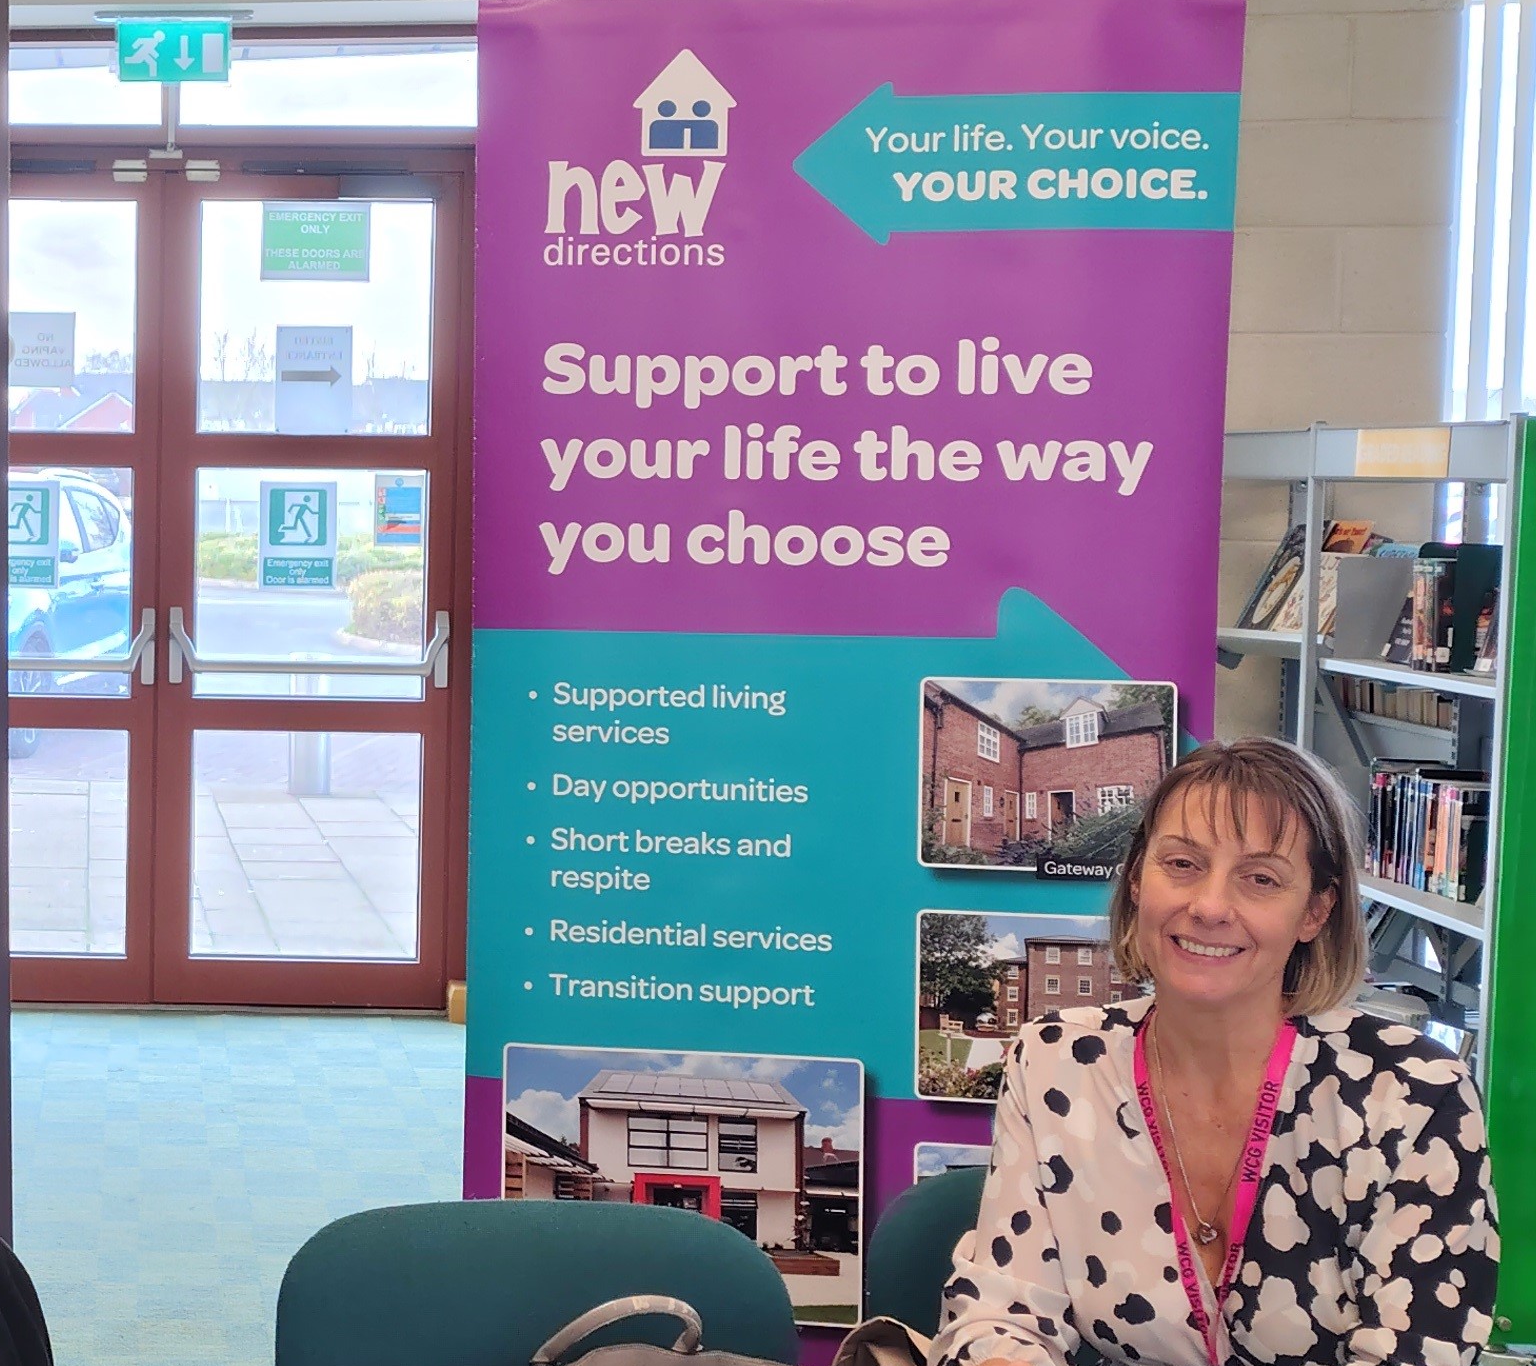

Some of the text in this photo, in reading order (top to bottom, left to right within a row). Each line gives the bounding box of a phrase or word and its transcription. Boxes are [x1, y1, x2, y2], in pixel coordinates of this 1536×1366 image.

[866, 122, 1209, 152] Your life. Your voice.
[544, 160, 726, 237] new
[893, 168, 1207, 201] YOUR CHOICE.
[269, 212, 362, 222] EMERGENCY EXIT
[300, 225, 330, 234] ONLY
[265, 249, 362, 258] THESE DOORS ARE
[544, 236, 724, 265] directions
[288, 261, 340, 270] ALARMED
[543, 337, 1092, 409] Support to live
[540, 423, 1153, 495] your life the way
[539, 510, 950, 574] you choose
[267, 559, 329, 568] Emergency exit
[289, 568, 306, 577] only
[266, 576, 329, 584] Door is alarmed
[554, 682, 786, 715] Supported living
[553, 720, 669, 744] services
[554, 774, 808, 804] Day opportunities
[552, 828, 791, 857] Short breaks and
[552, 866, 650, 894] respite
[1044, 861, 1113, 879] Gateway
[551, 920, 832, 951] Residential services
[549, 974, 815, 1009] Transition support
[1241, 1081, 1280, 1183] WCG VISITOR
